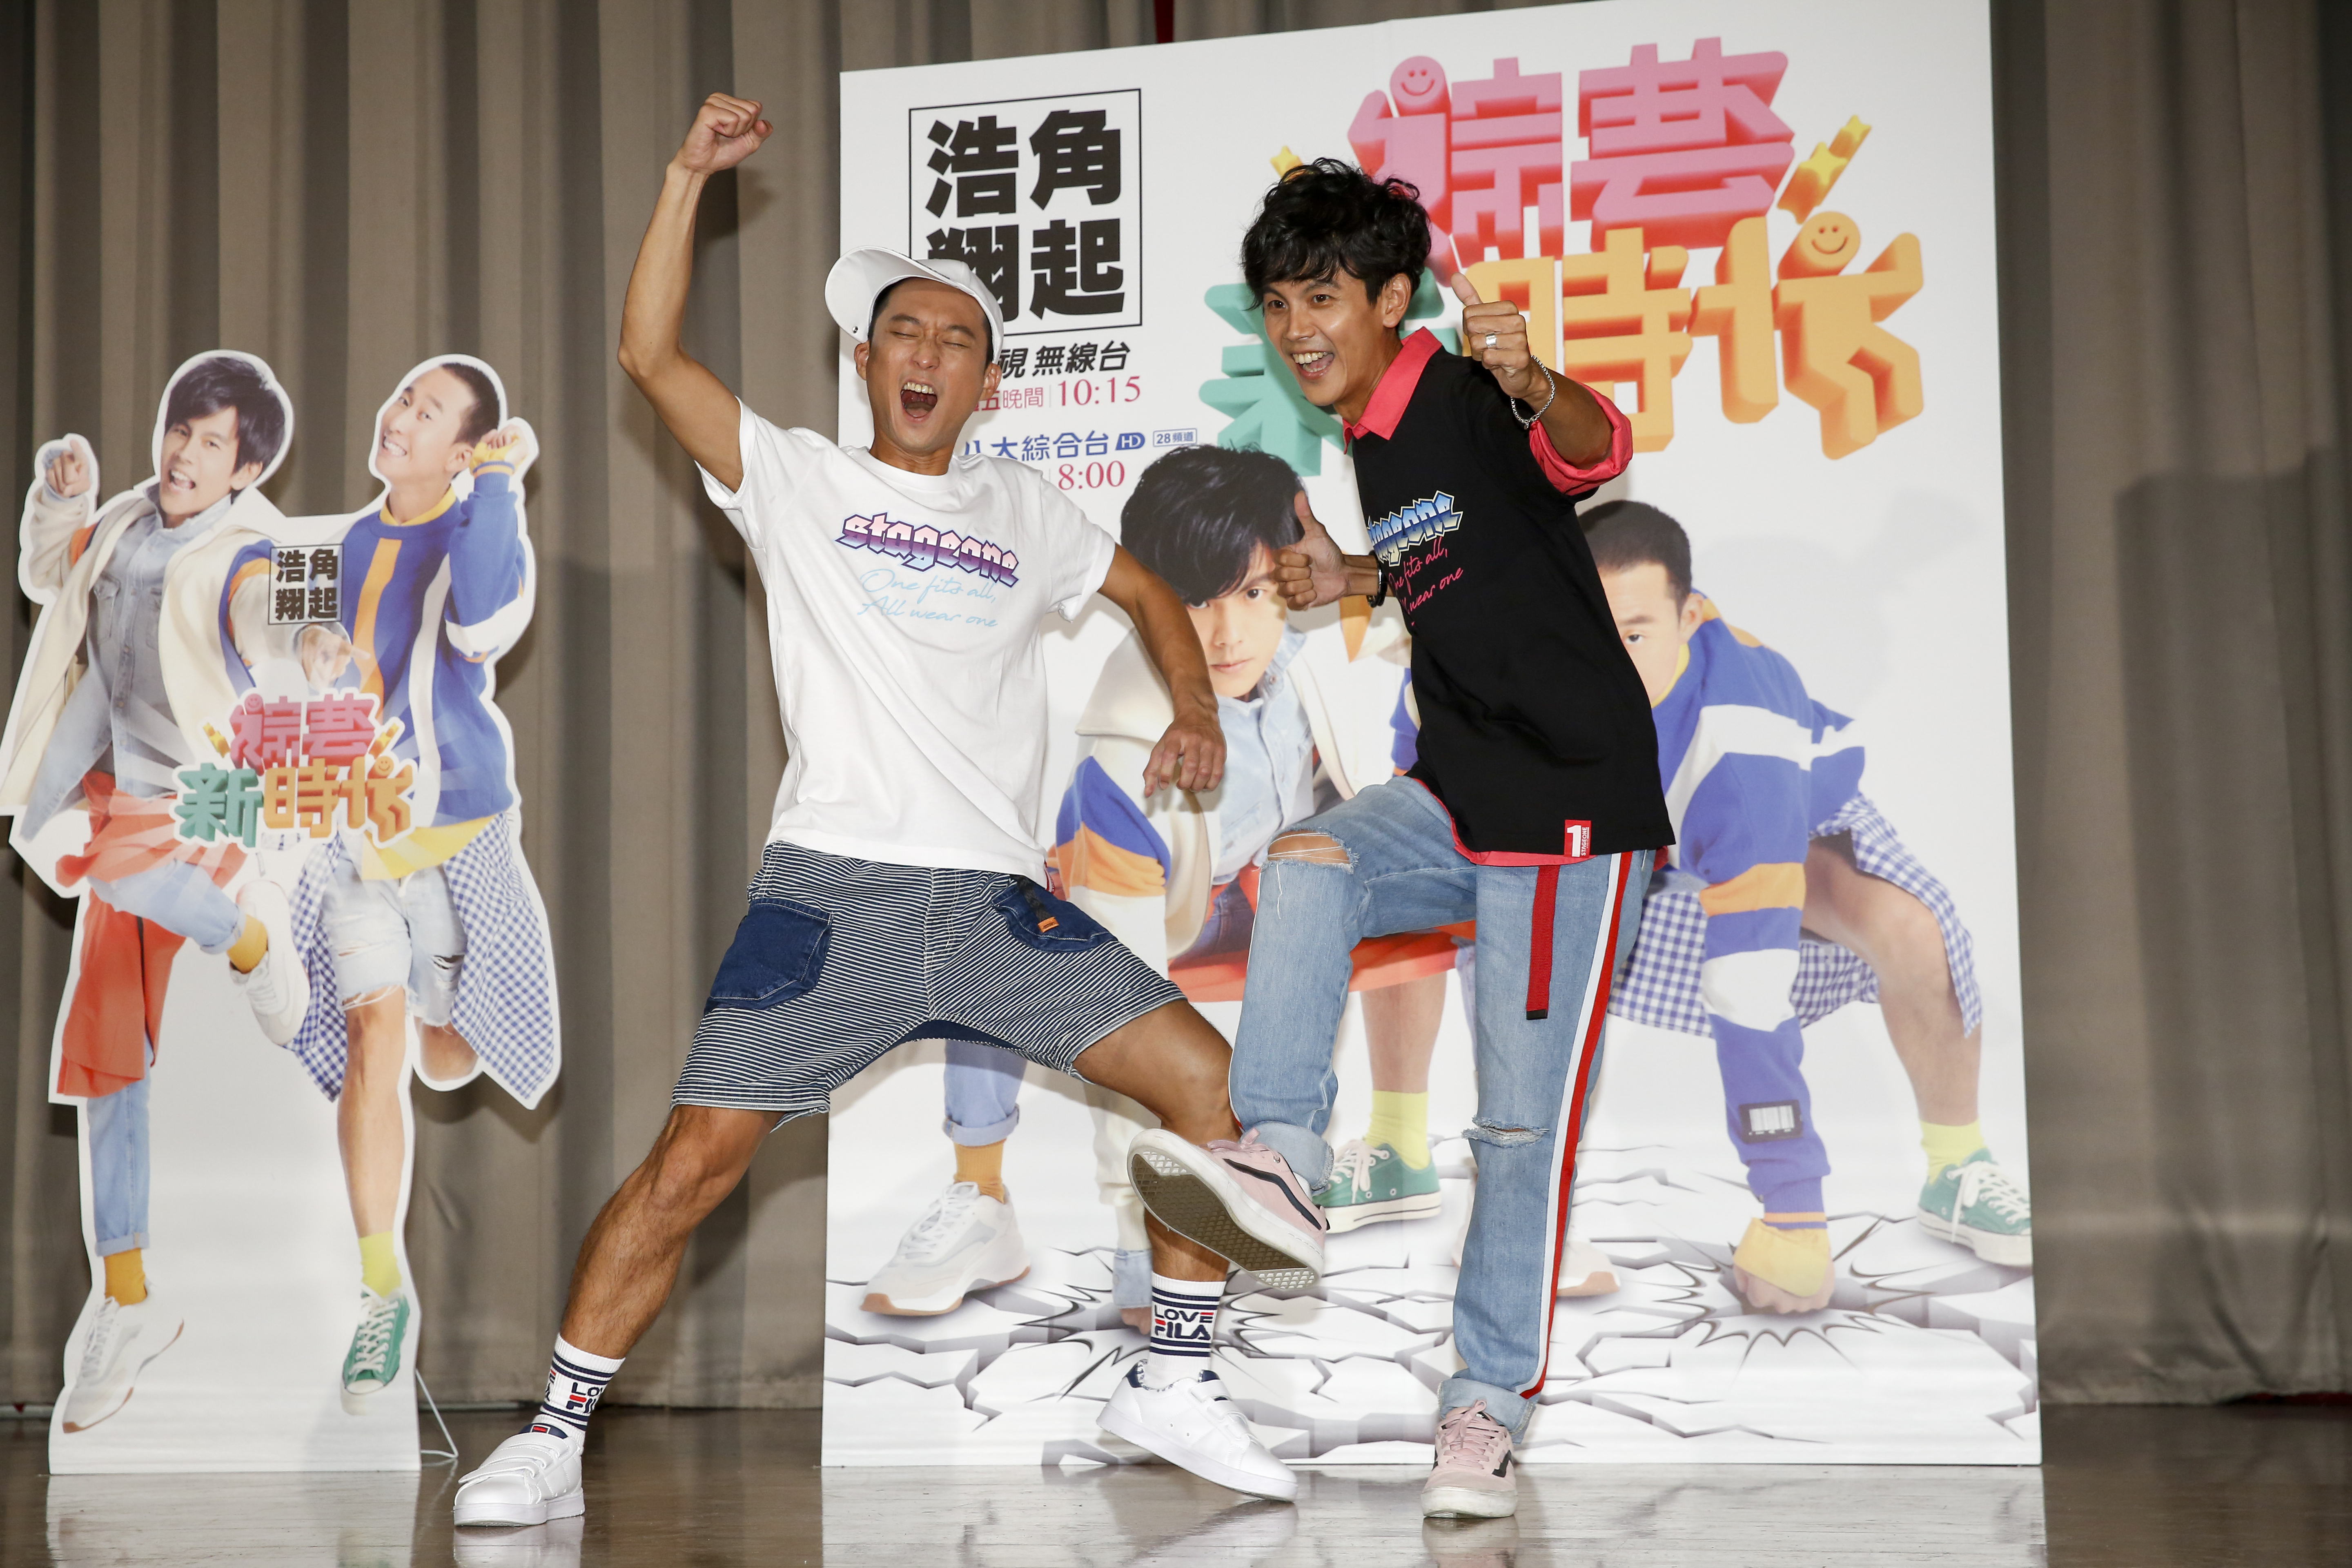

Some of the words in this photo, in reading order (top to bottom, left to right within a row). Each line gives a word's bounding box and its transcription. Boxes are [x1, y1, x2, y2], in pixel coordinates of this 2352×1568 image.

[925, 109, 1121, 218] 浩角
[1032, 340, 1130, 376] 無線台
[1058, 376, 1140, 406] 10:15
[1120, 434, 1142, 449] HD
[1058, 460, 1125, 490] 8:00
[276, 549, 338, 583] 浩角
[835, 512, 1019, 588] stageone
[860, 569, 920, 592] One
[917, 578, 964, 604] fits
[1439, 568, 1463, 589] one
[276, 587, 338, 621] 翔起
[966, 615, 998, 627] one
[175, 756, 414, 848] 新時代
[1154, 1305, 1214, 1323] LOVE
[1155, 1319, 1211, 1340] FILA
